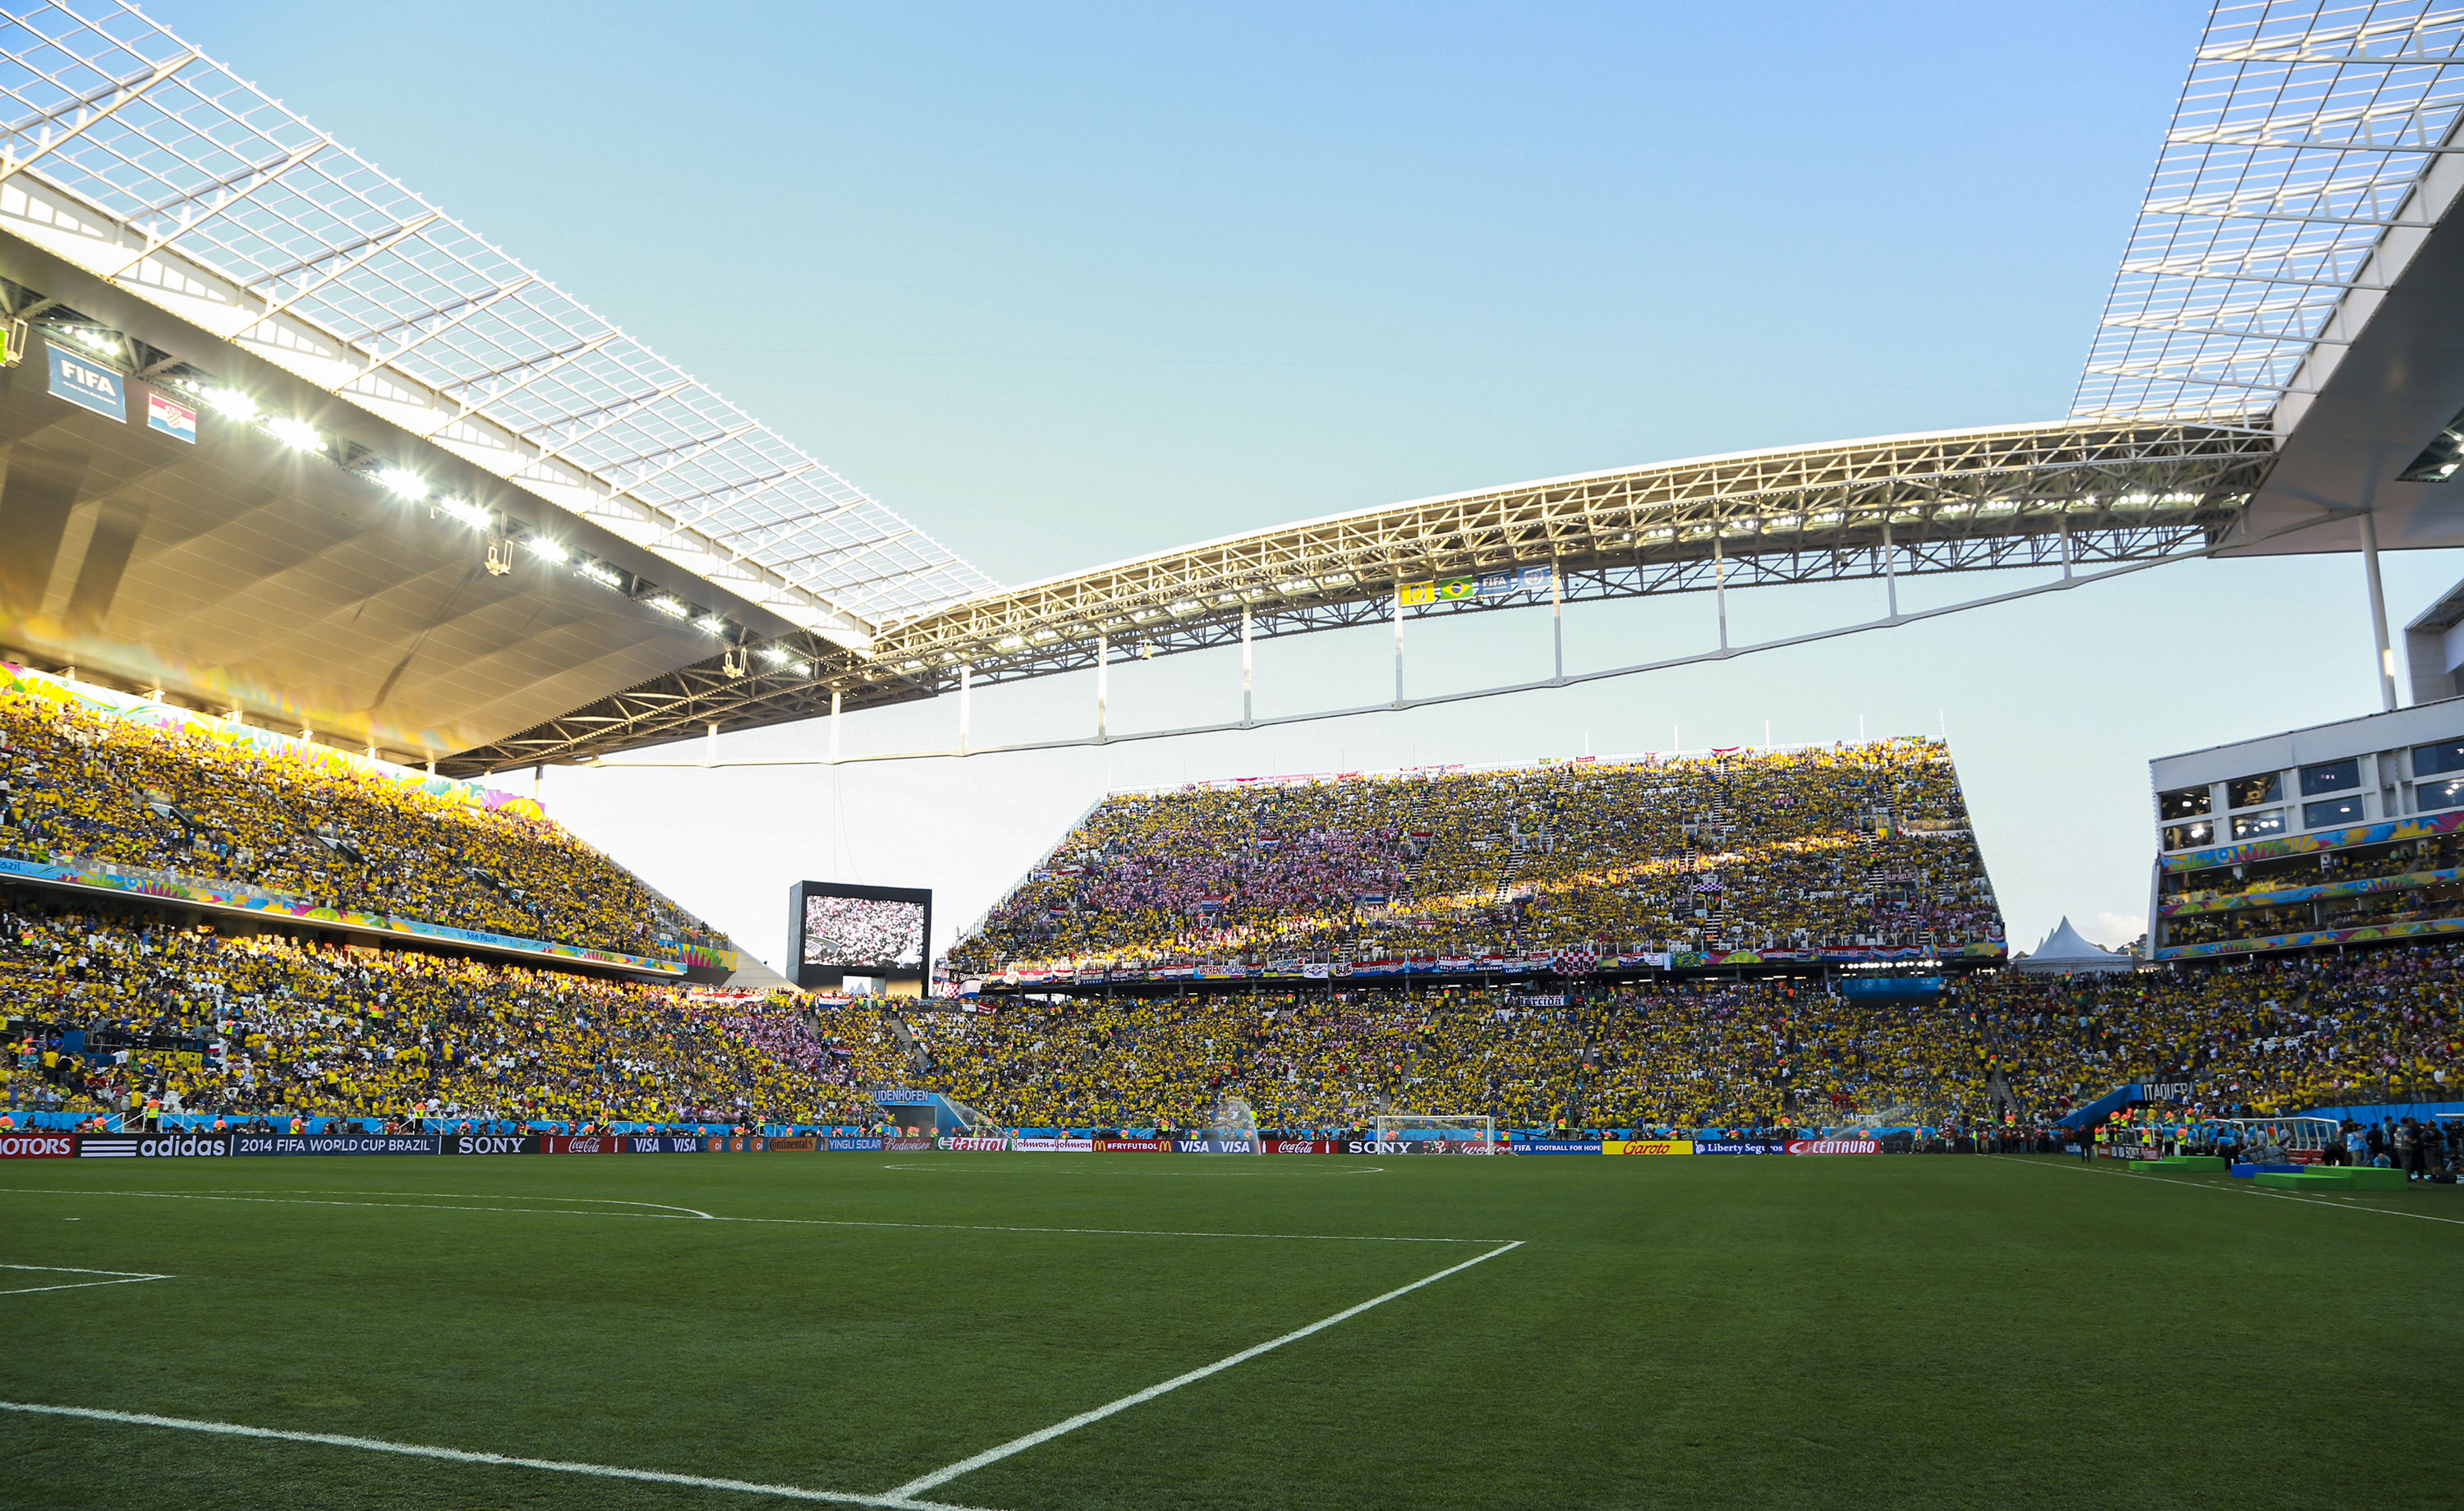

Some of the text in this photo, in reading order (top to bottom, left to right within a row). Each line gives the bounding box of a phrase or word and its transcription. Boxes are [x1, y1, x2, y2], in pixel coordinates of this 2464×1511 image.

[61, 359, 116, 397] FIFA
[1483, 576, 1507, 586] FIFA
[0, 861, 21, 872] azil
[480, 933, 498, 944] Paulo
[1222, 965, 1245, 974] CHICAGO
[0, 1137, 71, 1155] OTORS
[140, 1135, 225, 1157] adidas
[240, 1139, 273, 1152] 2014
[276, 1139, 306, 1151] FIFA
[310, 1139, 357, 1151] WORLD
[361, 1139, 386, 1151] CUP
[458, 1137, 526, 1154] SONY
[568, 1137, 601, 1154] Coca-Cola
[633, 1138, 696, 1152] VISA VISA
[769, 1138, 807, 1151] Continental
[829, 1139, 881, 1150] YINGLI SOLAR
[883, 1137, 931, 1151] Budweiser
[952, 1137, 1004, 1151] Castrol
[1177, 1141, 1250, 1153] VISA VISA
[1278, 1141, 1315, 1153] Coca-Cola
[1349, 1141, 1413, 1154] SONY
[1623, 1141, 1671, 1155] Garoto
[1708, 1143, 1744, 1154] Liberty
[1812, 1141, 1876, 1154] CENTAURO
